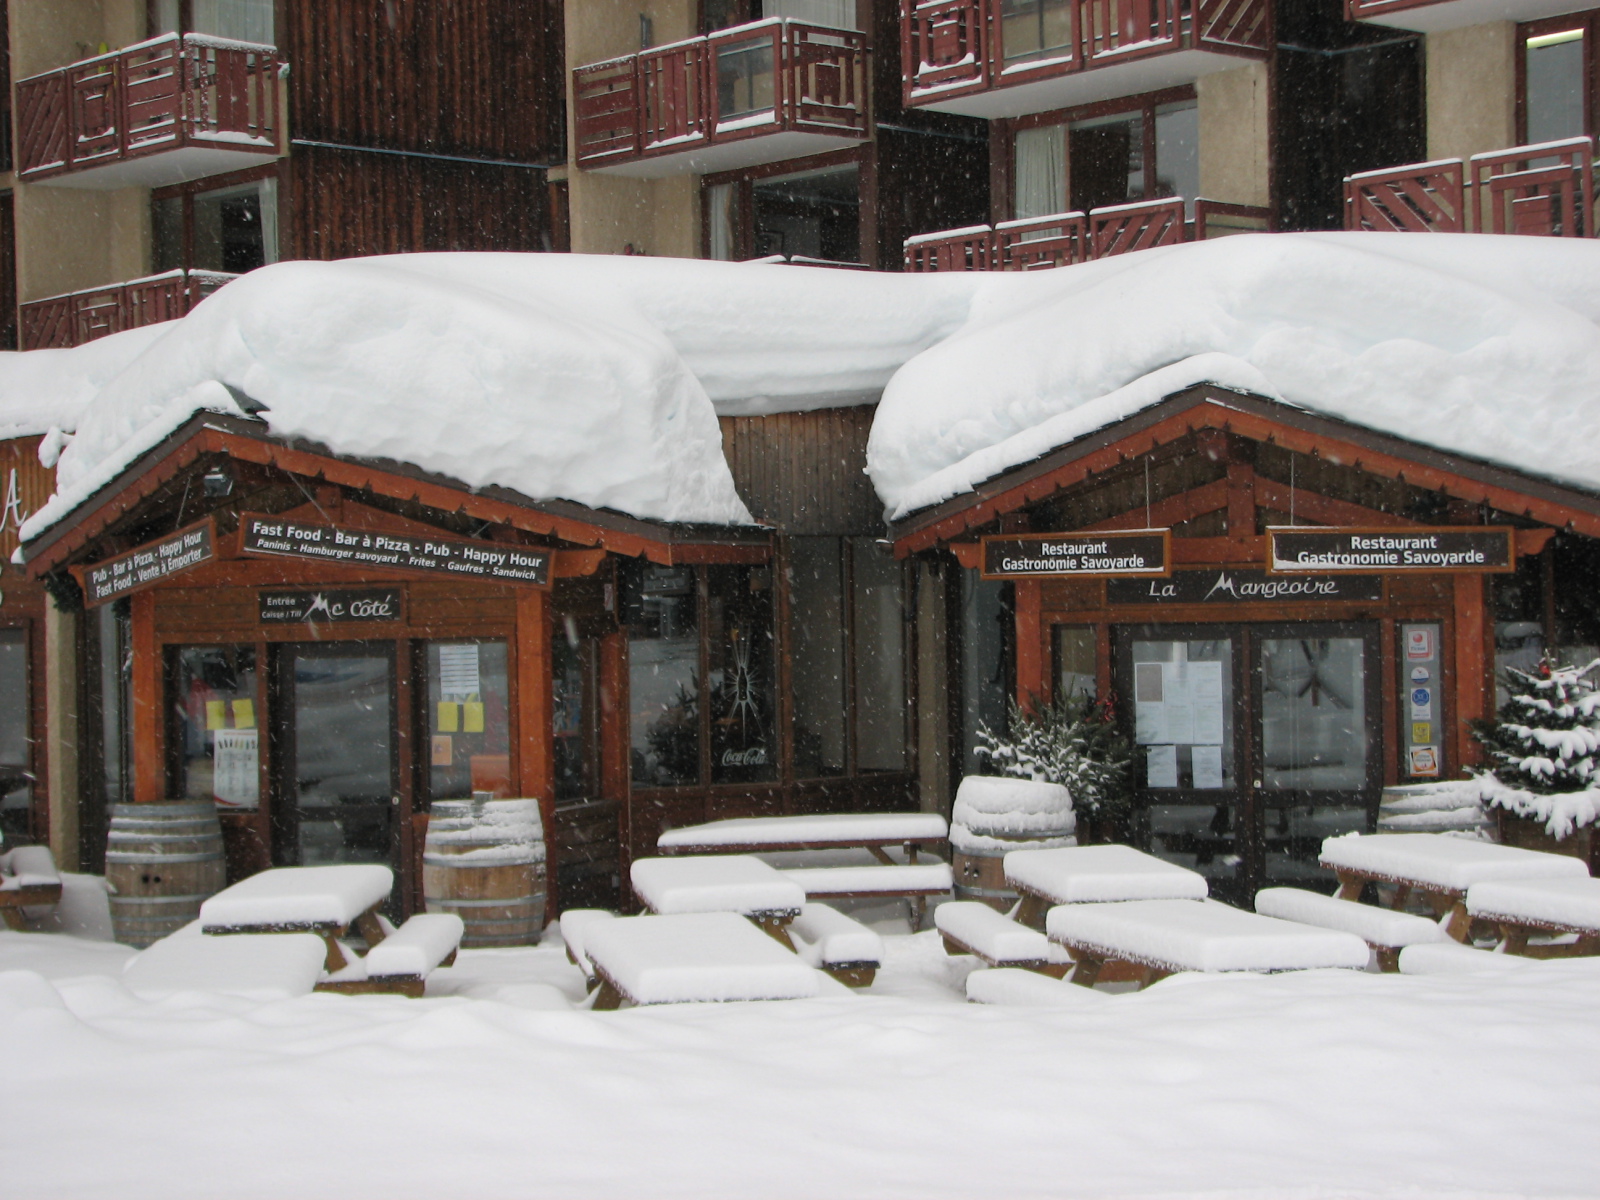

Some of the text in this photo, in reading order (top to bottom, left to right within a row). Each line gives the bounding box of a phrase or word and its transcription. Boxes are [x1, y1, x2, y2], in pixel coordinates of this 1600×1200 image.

[253, 522, 282, 536] Fast
[287, 526, 321, 541] Food
[335, 531, 359, 546] Bar
[362, 535, 371, 548] à
[375, 537, 410, 552] Pizza
[424, 543, 450, 556] Pub
[463, 547, 506, 566] Happy
[510, 553, 542, 567] Hour
[1041, 541, 1107, 556] Restaurant
[1351, 536, 1437, 549] Restaurant
[92, 568, 107, 584] Pub
[113, 562, 126, 577] Bar
[127, 558, 133, 571] à
[134, 552, 153, 569] Pizza
[159, 540, 183, 558] Happy
[184, 531, 202, 549] Hour
[257, 539, 291, 551] Paninis
[300, 544, 354, 559] Hamburger
[355, 551, 398, 564] savoyard
[408, 556, 436, 568] Frites
[447, 561, 484, 574] Gaufres
[492, 566, 536, 580] Sandwich
[1002, 554, 1144, 571] Gastronomie Savoyarde
[1298, 549, 1485, 566] Gastronomie Savoyarde
[96, 583, 112, 598] Fast
[113, 575, 132, 592] Food
[137, 565, 160, 582] Vente
[161, 561, 166, 573] à
[167, 548, 202, 571] Emporter
[1149, 581, 1176, 596] La
[267, 597, 296, 606] Entrée
[350, 594, 392, 617] Côté
